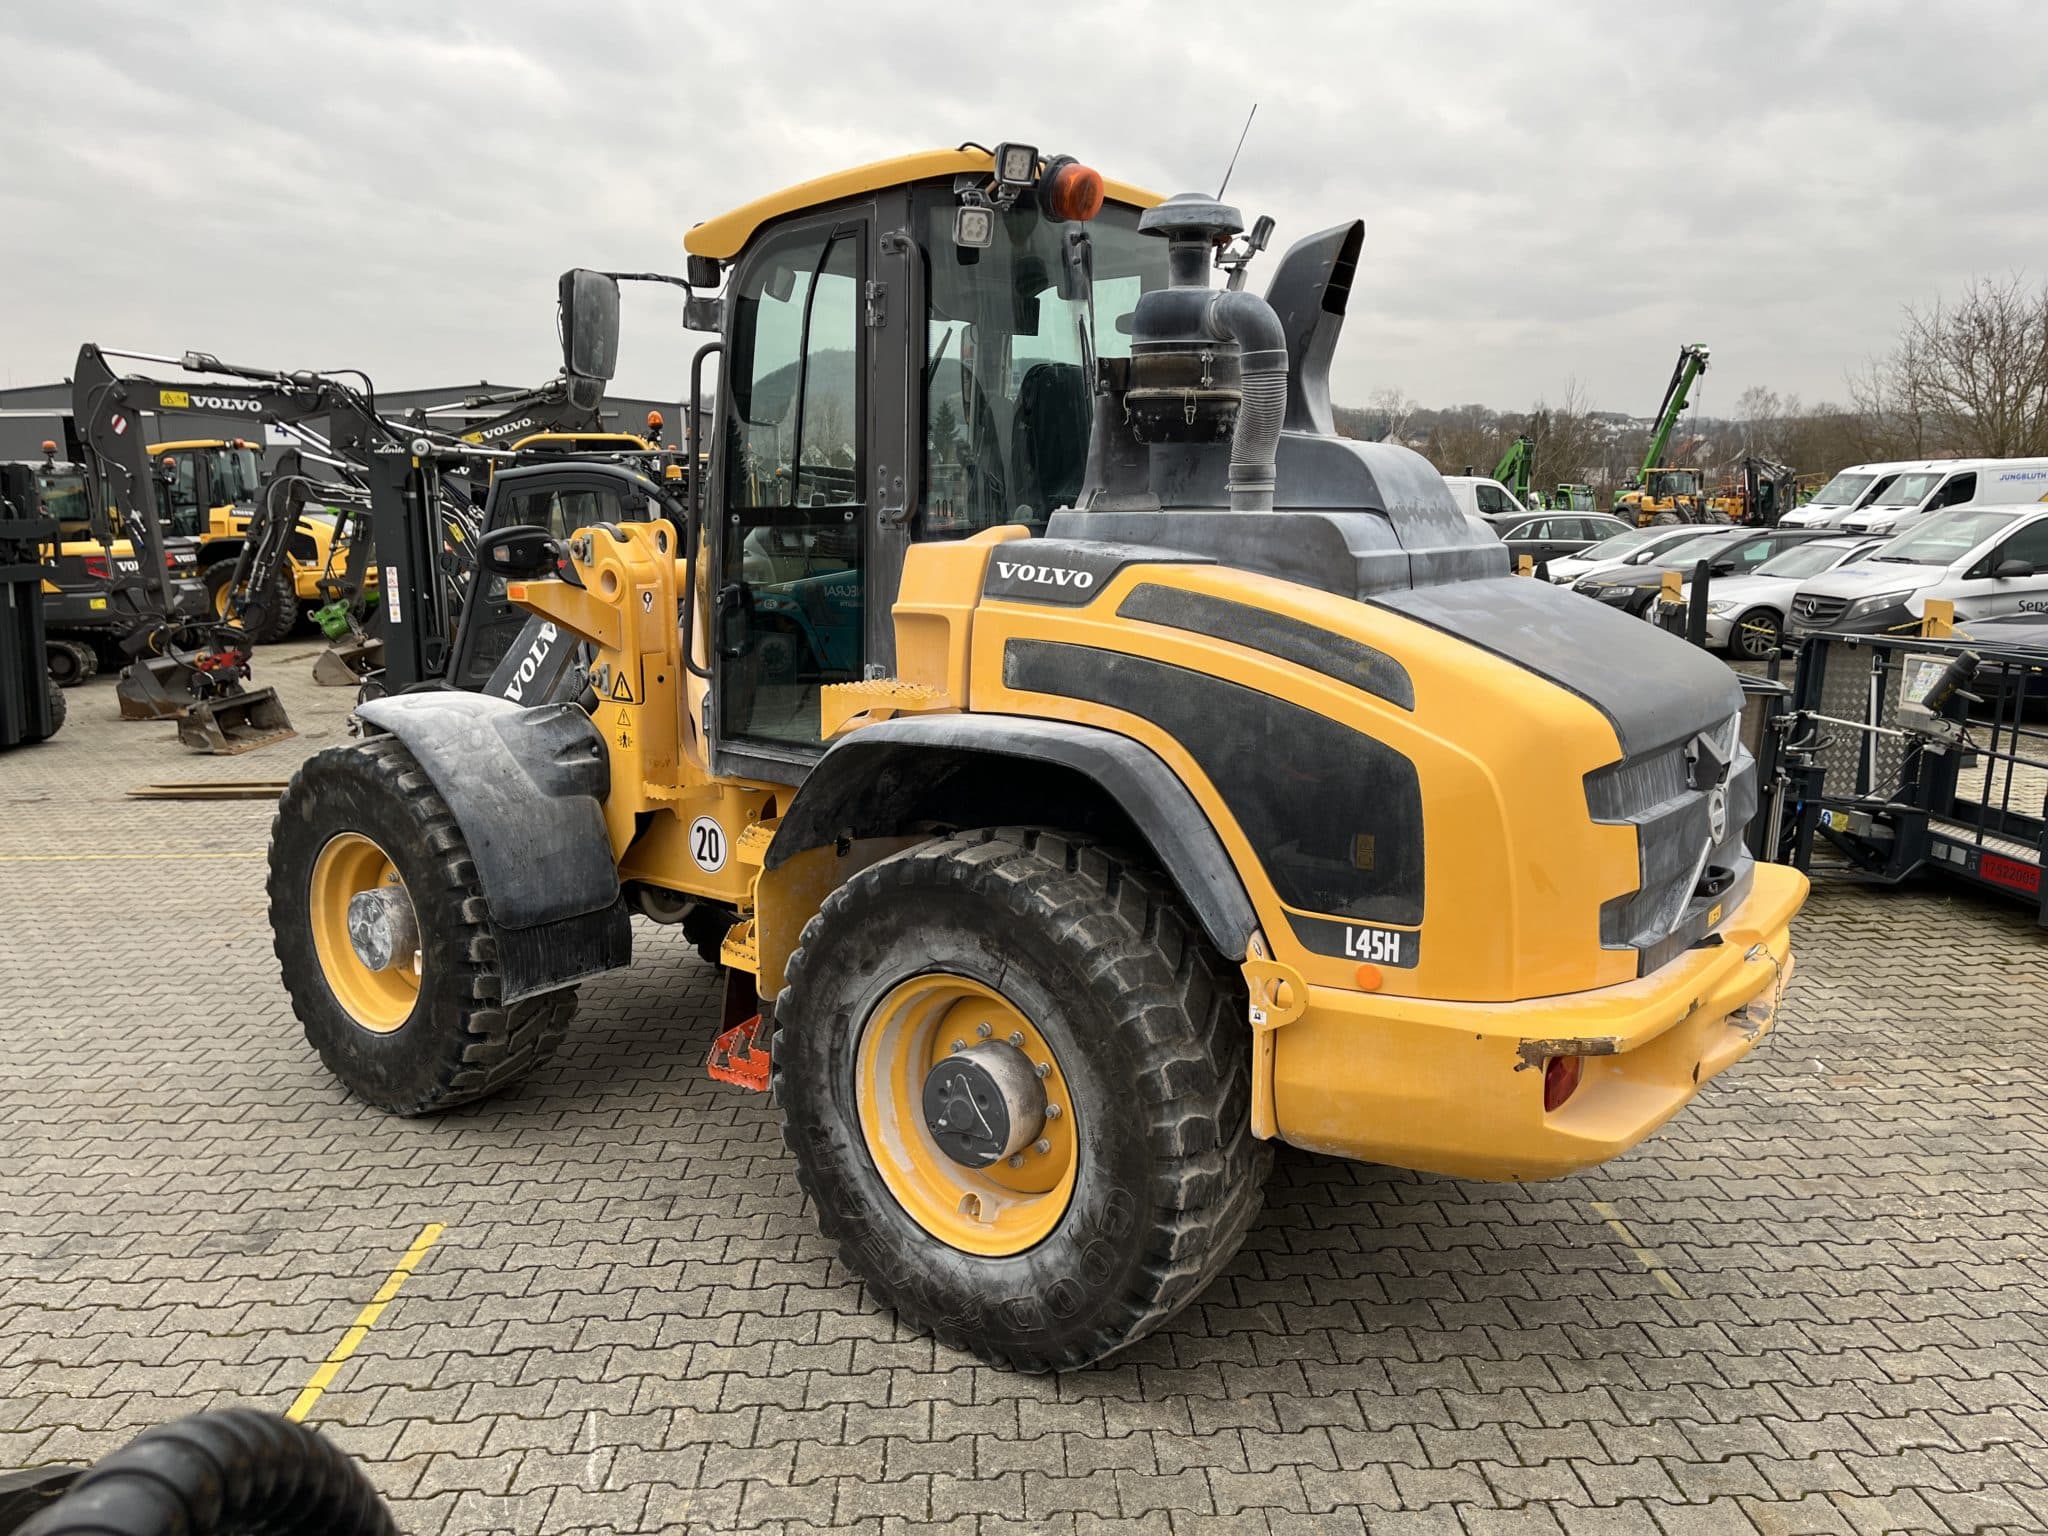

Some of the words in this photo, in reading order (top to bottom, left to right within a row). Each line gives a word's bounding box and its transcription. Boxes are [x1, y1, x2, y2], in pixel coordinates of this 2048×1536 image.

[190, 395, 263, 412] VOLVO
[482, 418, 531, 439] VOLVO
[996, 561, 1094, 589] VOLVO
[696, 826, 720, 863] 20
[1345, 926, 1401, 964] L45H
